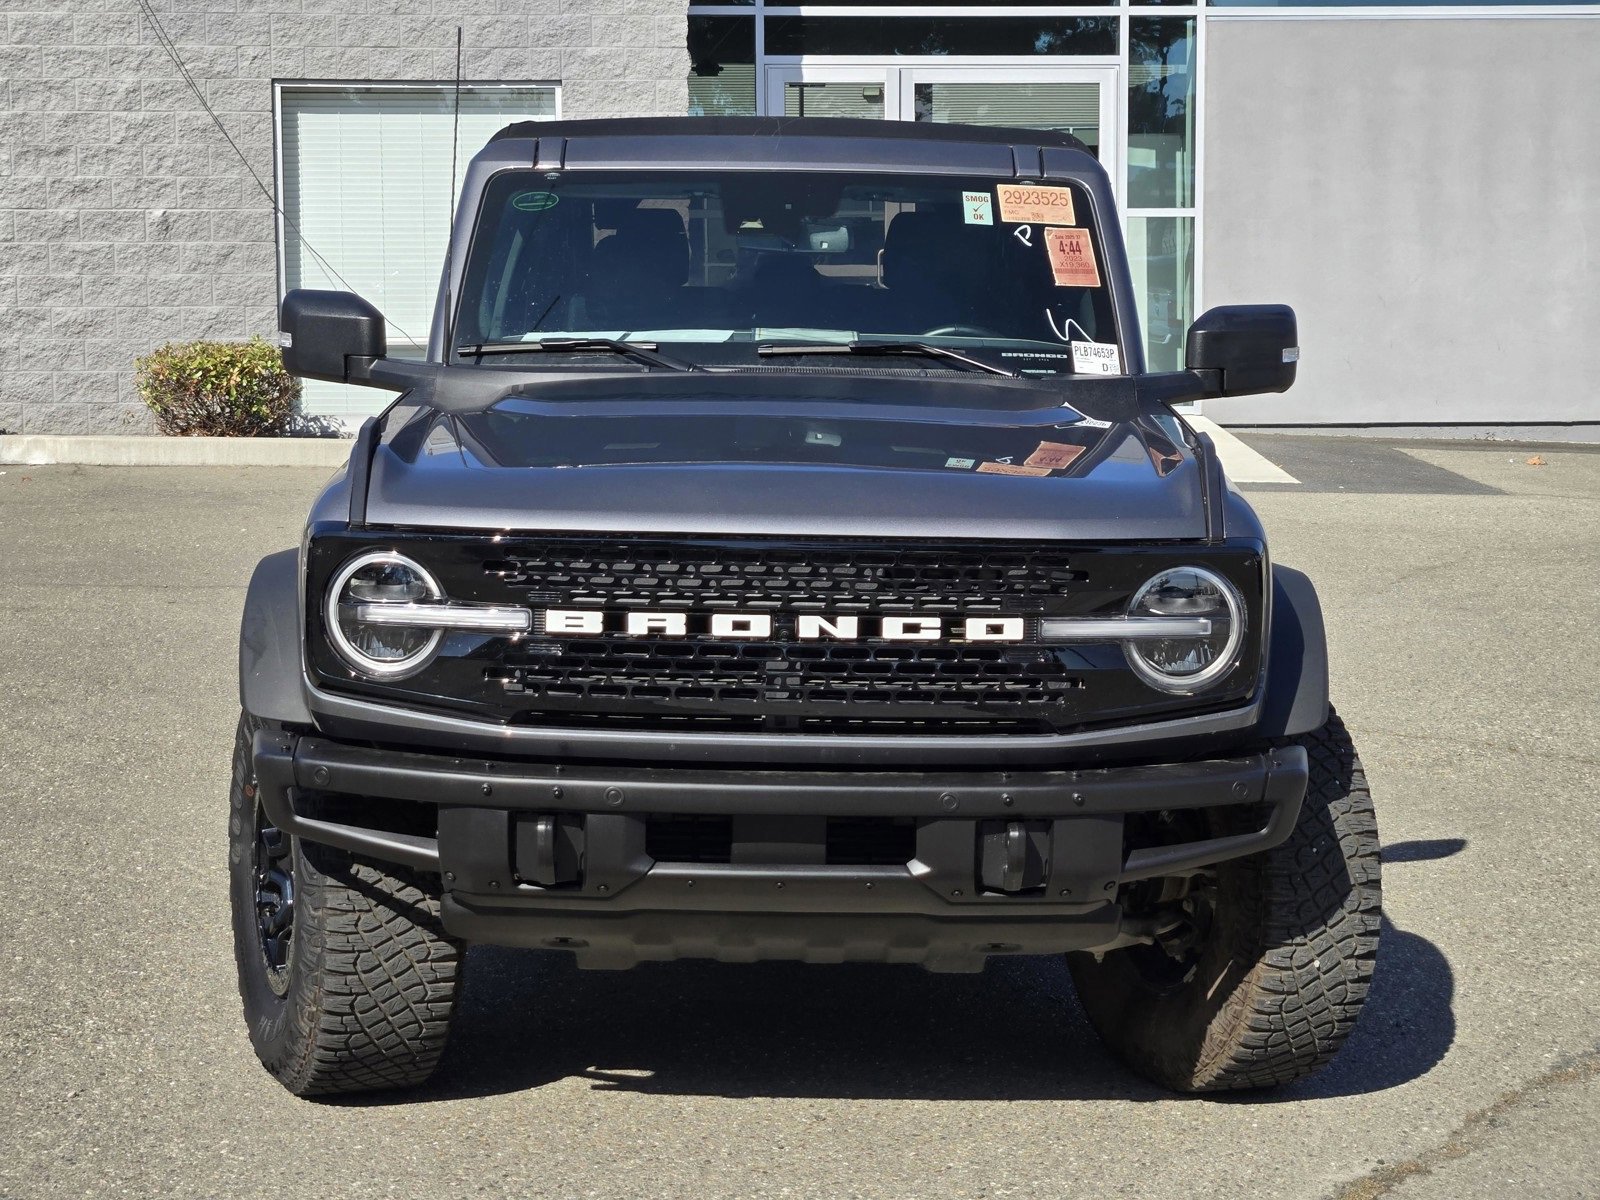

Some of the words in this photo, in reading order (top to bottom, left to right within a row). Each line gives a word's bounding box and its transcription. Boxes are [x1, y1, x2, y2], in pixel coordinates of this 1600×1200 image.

[965, 195, 989, 203] SMOG
[1003, 190, 1069, 207] 2923525
[1059, 240, 1082, 255] 4:44
[1074, 345, 1115, 359] PLB74653P
[1102, 363, 1109, 372] D
[545, 610, 1025, 641] BRONCO
